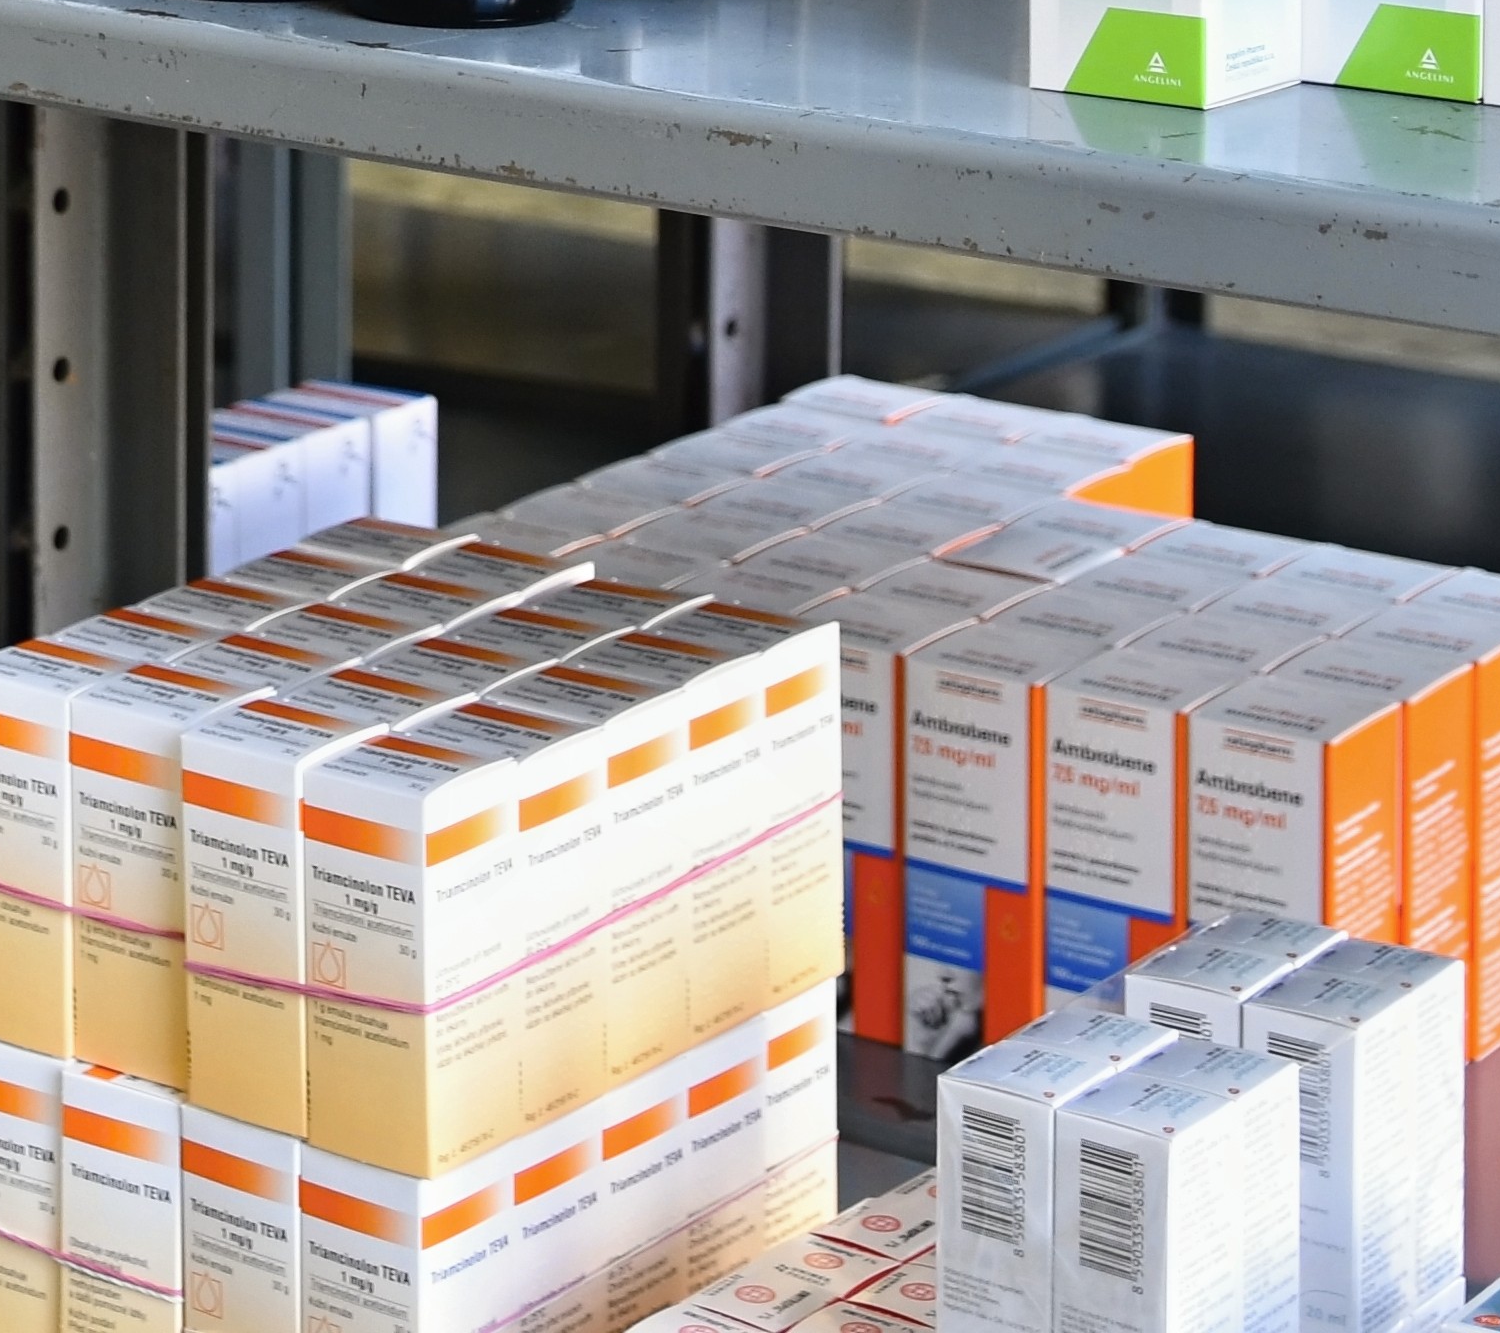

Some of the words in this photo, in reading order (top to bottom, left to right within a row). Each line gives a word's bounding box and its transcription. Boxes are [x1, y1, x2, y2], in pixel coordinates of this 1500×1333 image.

[1134, 75, 1181, 87] ANGELINI
[1405, 70, 1454, 83] ANGELINI
[31, 779, 58, 798] TEVA
[79, 792, 147, 821] Triamcinolon
[149, 811, 177, 830] TEVA
[190, 828, 259, 860] Triamcinolon
[261, 849, 289, 867] TEVA
[222, 857, 227, 867] 1
[312, 866, 384, 896] Triamcinolon
[386, 884, 416, 905] TEVA
[346, 894, 350, 905] 1
[70, 1164, 140, 1195] Triamcinolon
[143, 1185, 172, 1204] TEVA
[190, 1198, 258, 1232] Triamcinolon
[259, 1222, 288, 1242] TEVA
